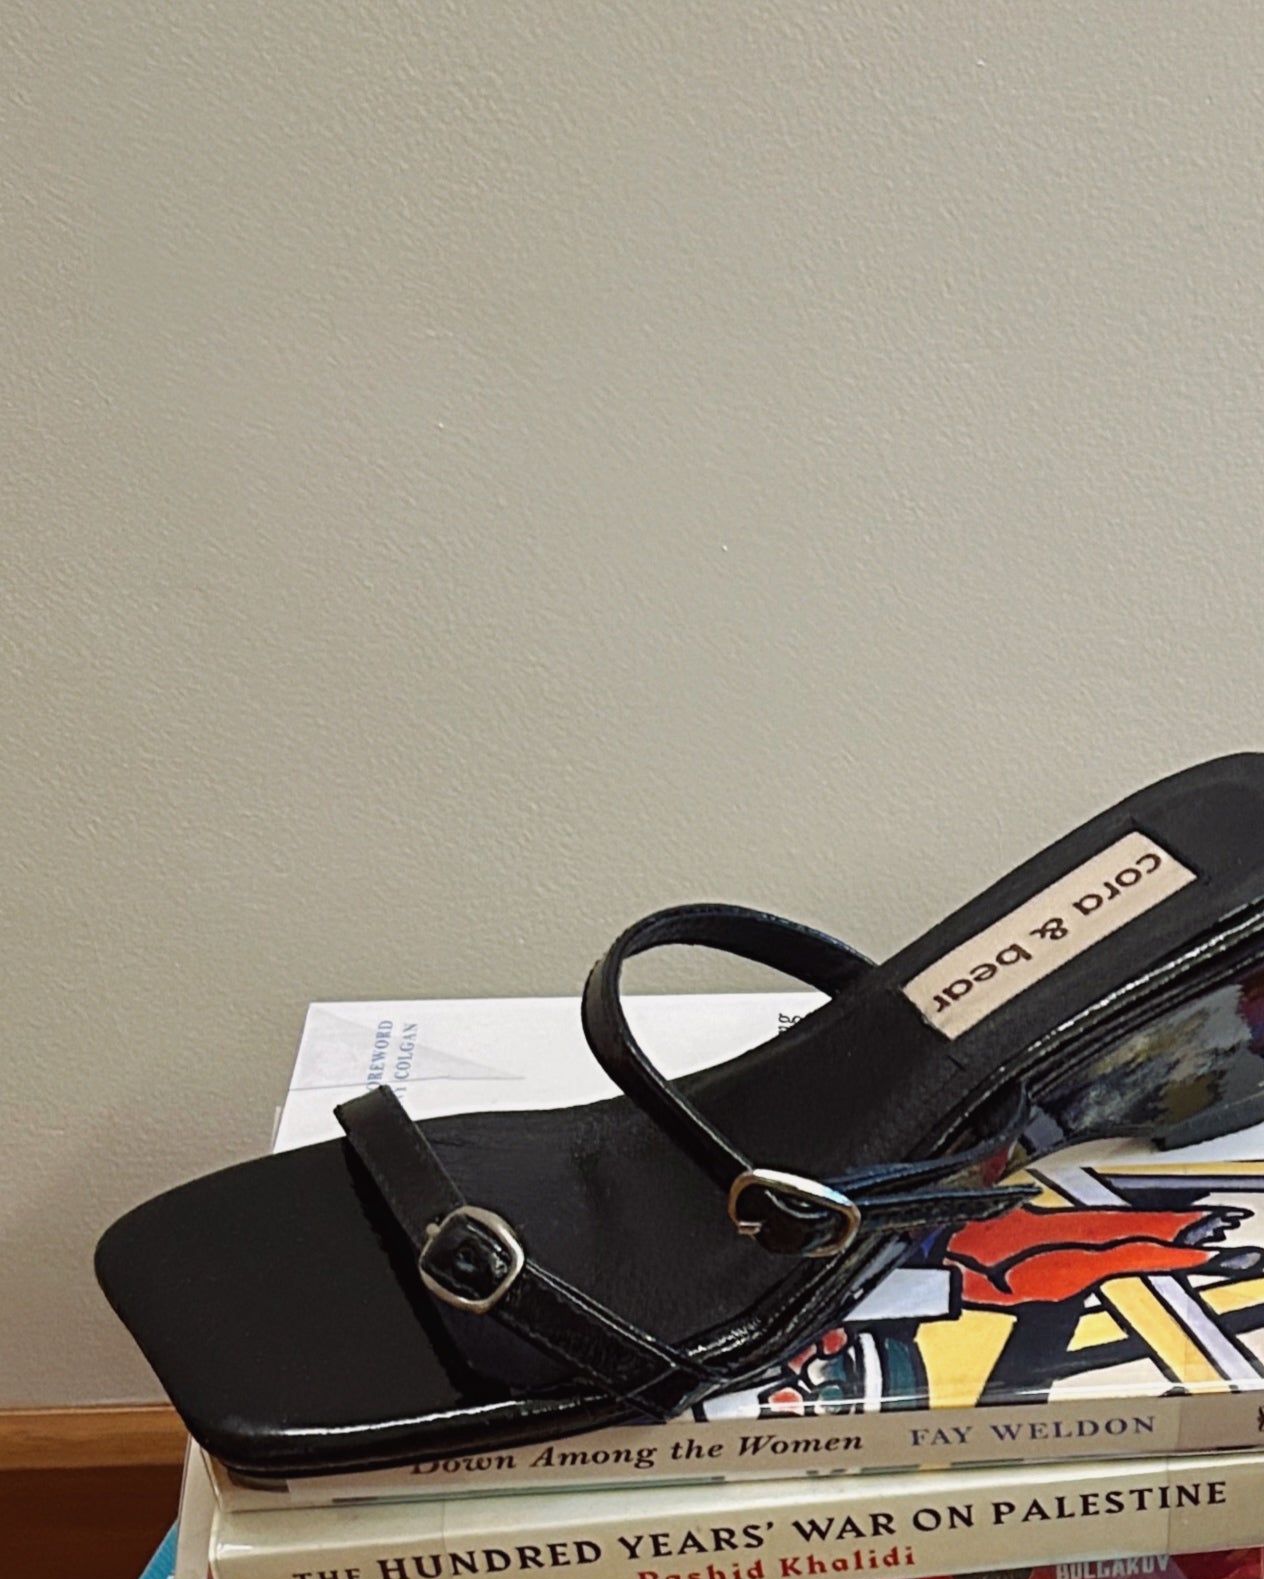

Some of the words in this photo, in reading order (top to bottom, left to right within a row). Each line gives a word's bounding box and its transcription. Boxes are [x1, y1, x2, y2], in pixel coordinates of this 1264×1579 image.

[1071, 852, 1162, 916] cora
[1028, 916, 1070, 941] &
[932, 943, 1033, 1013] bear
[366, 1019, 394, 1092] OREWORD
[530, 1445, 658, 1471] Among
[671, 1438, 725, 1462] the
[737, 1434, 864, 1457] Women
[910, 1424, 974, 1447] FAY
[989, 1415, 1157, 1442] WELDON
[792, 1509, 896, 1543] WAR
[911, 1502, 976, 1533] ON
[991, 1480, 1228, 1527] PALESTINE
[780, 1545, 917, 1579] Khalidi
